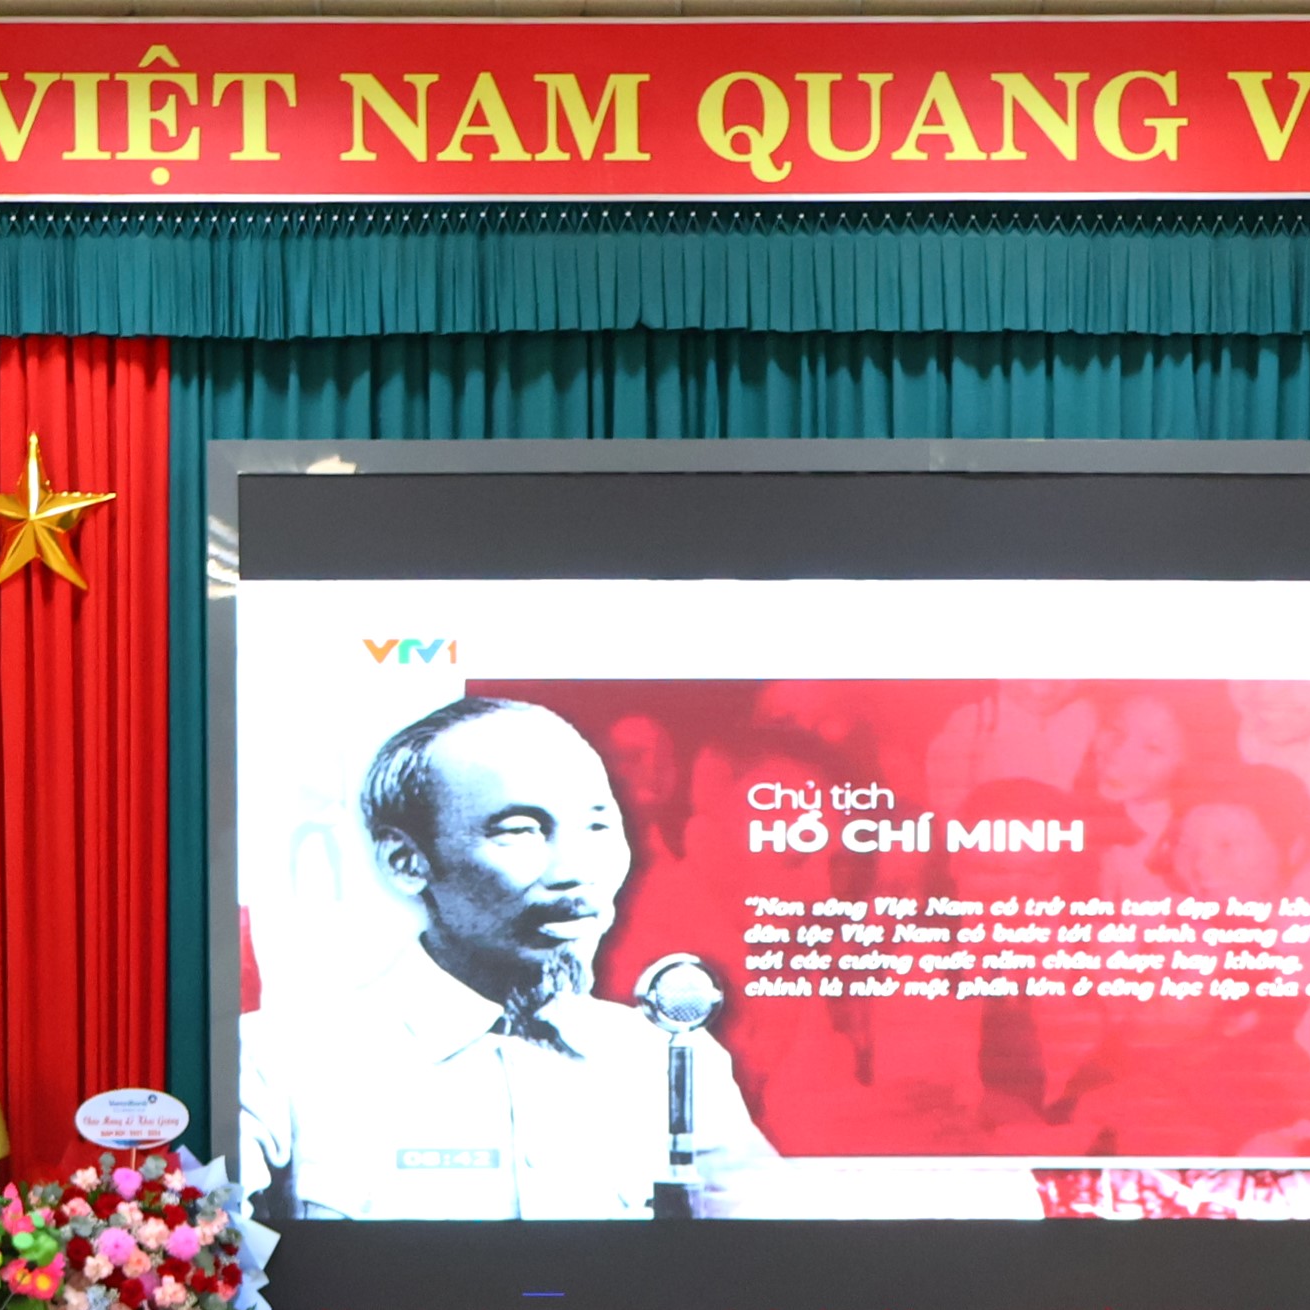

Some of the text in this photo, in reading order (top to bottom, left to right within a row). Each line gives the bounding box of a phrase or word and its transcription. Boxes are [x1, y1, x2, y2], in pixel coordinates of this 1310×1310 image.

[340, 73, 651, 162] NAM
[697, 71, 1189, 183] QUANG
[747, 780, 894, 816] Chủ tịch
[841, 812, 935, 853] CHÍ
[946, 819, 1084, 853] MINH
[925, 897, 983, 916] Nam
[990, 897, 1019, 916] có
[1226, 897, 1272, 922] hay
[892, 924, 950, 943] Nam
[1171, 950, 1217, 976] hay
